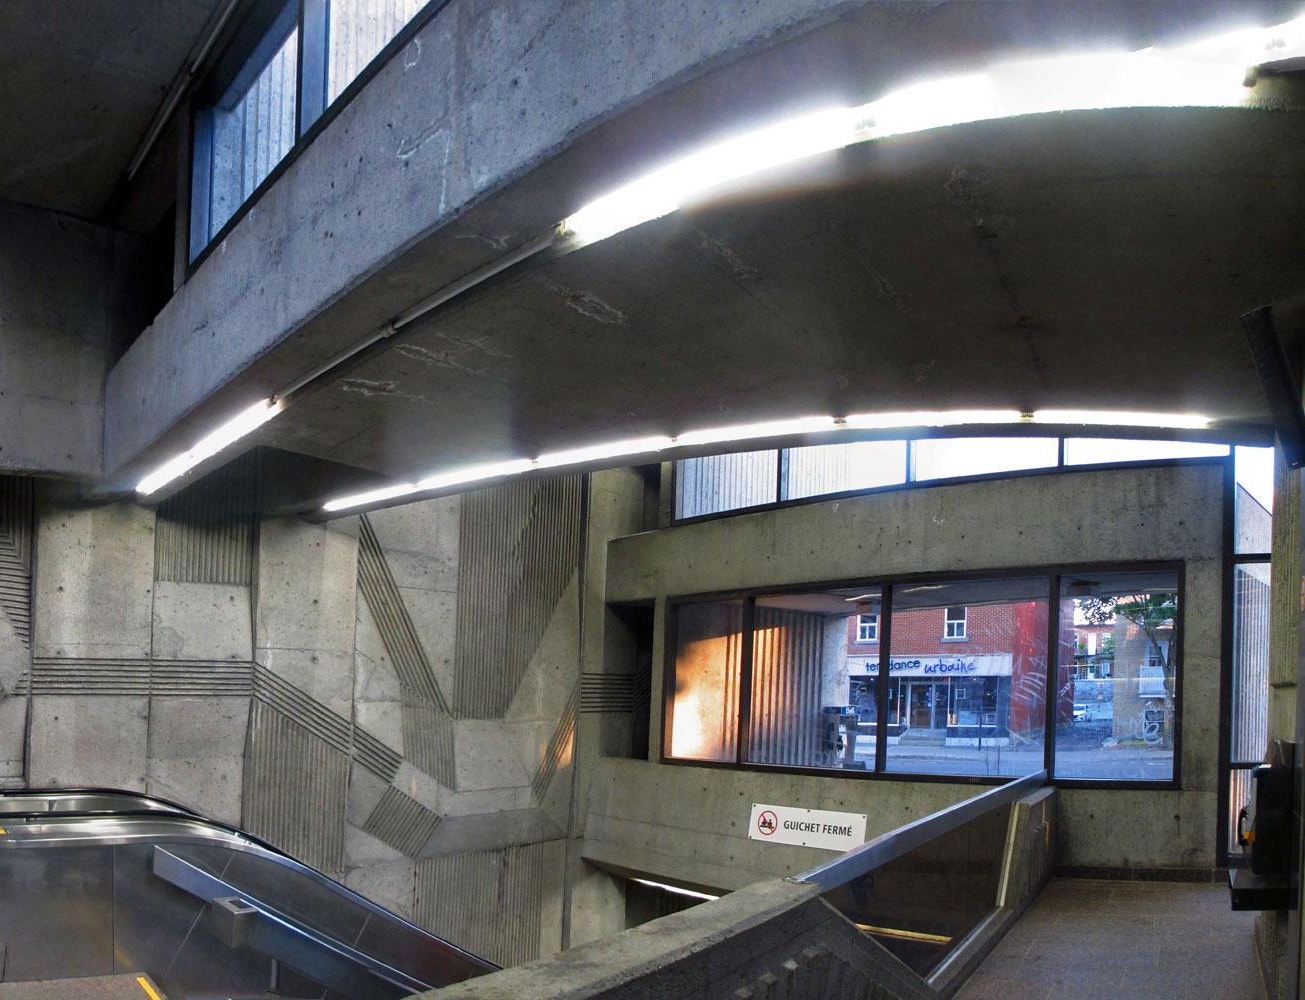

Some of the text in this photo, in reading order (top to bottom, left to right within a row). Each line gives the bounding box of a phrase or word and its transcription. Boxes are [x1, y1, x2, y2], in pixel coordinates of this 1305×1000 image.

[924, 658, 975, 674] urbaine
[783, 820, 853, 837] GUICHET FERMÉ
